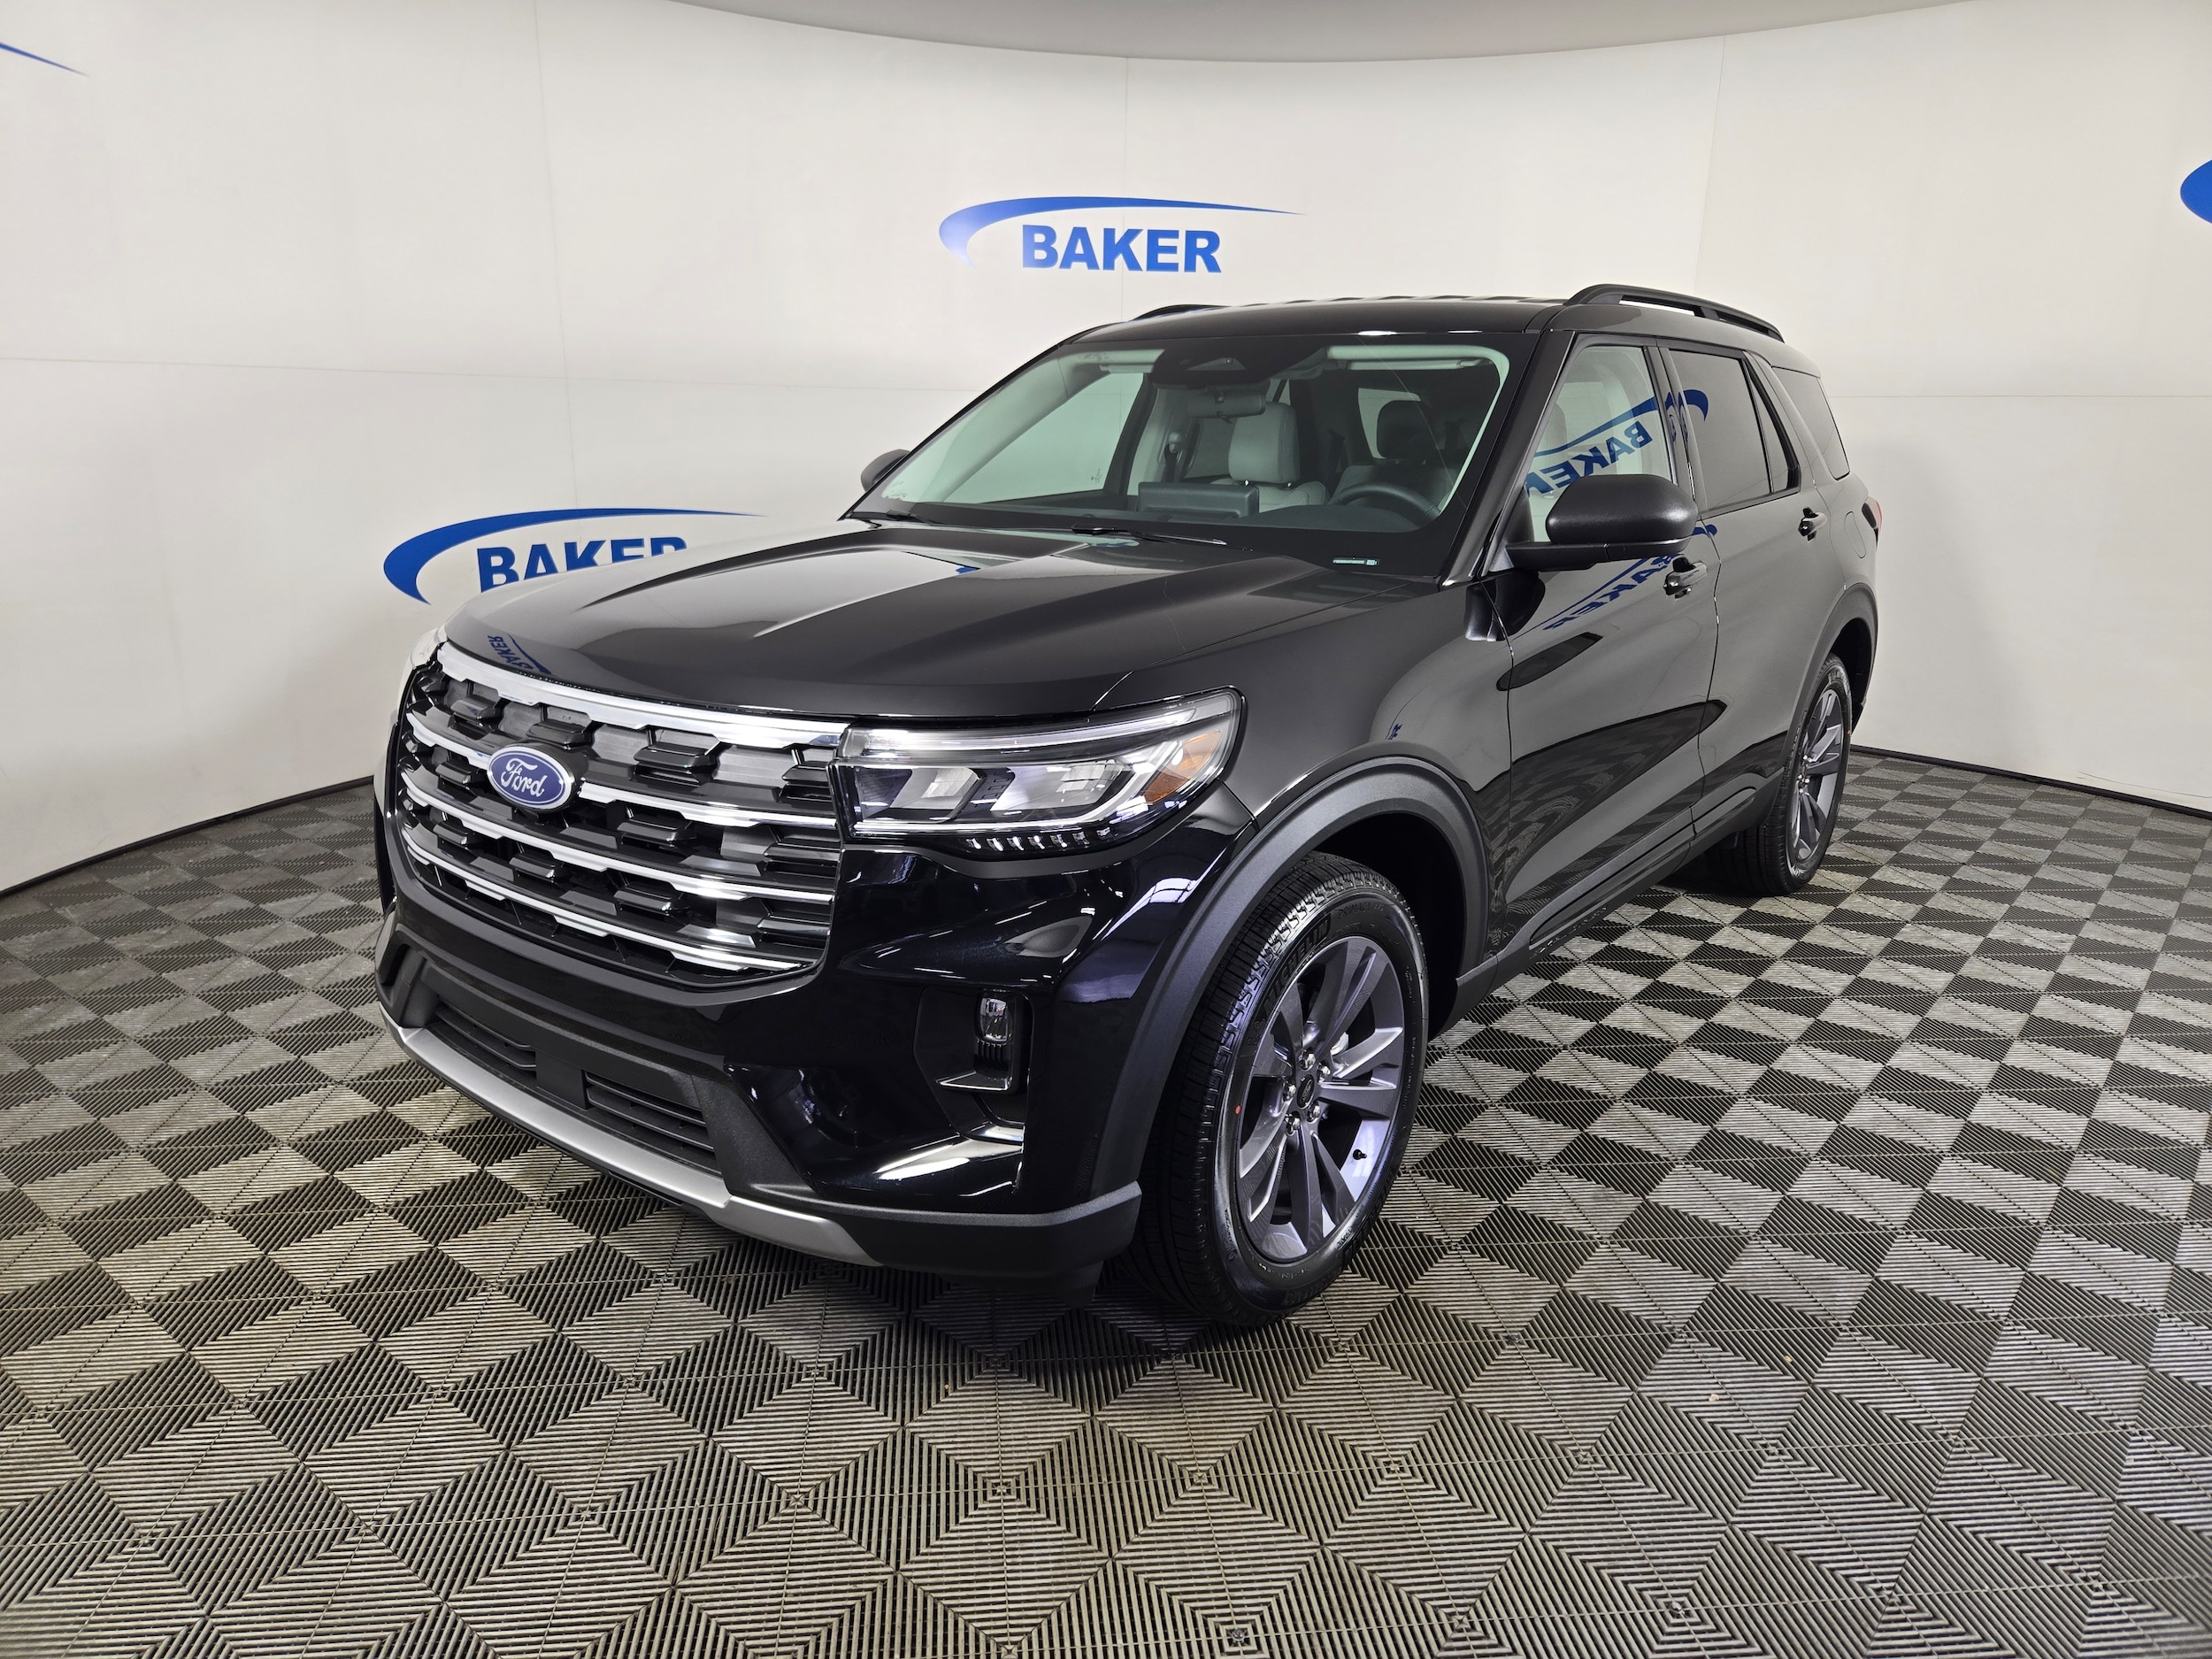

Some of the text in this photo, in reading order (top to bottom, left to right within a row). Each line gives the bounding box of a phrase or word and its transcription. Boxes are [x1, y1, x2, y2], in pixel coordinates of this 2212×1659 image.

[1022, 224, 1222, 273] BAKER
[500, 757, 547, 797] Ford
[1263, 919, 1329, 1018] MICHELIN
